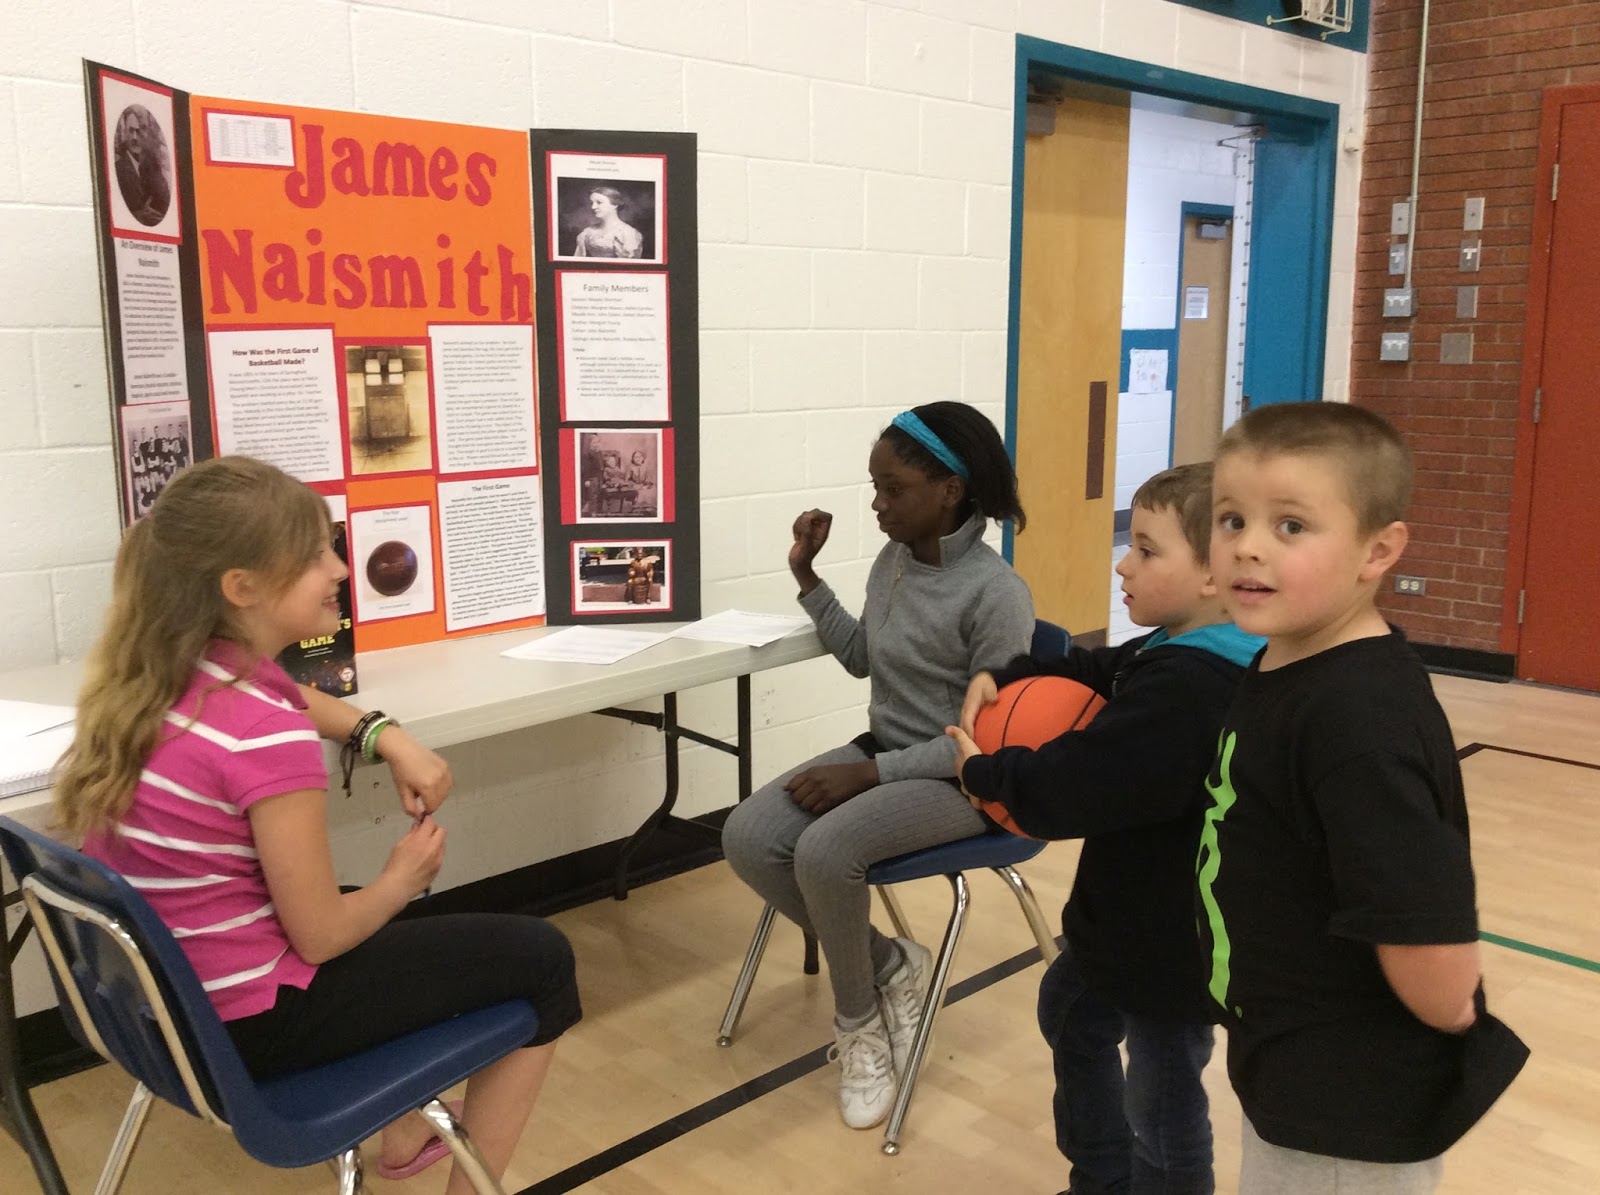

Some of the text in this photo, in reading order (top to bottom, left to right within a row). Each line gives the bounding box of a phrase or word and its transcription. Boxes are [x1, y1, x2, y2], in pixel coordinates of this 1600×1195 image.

[285, 124, 497, 209] James
[201, 228, 533, 322] Naismith
[583, 284, 649, 293] Family Members
[300, 635, 336, 649] GAME
